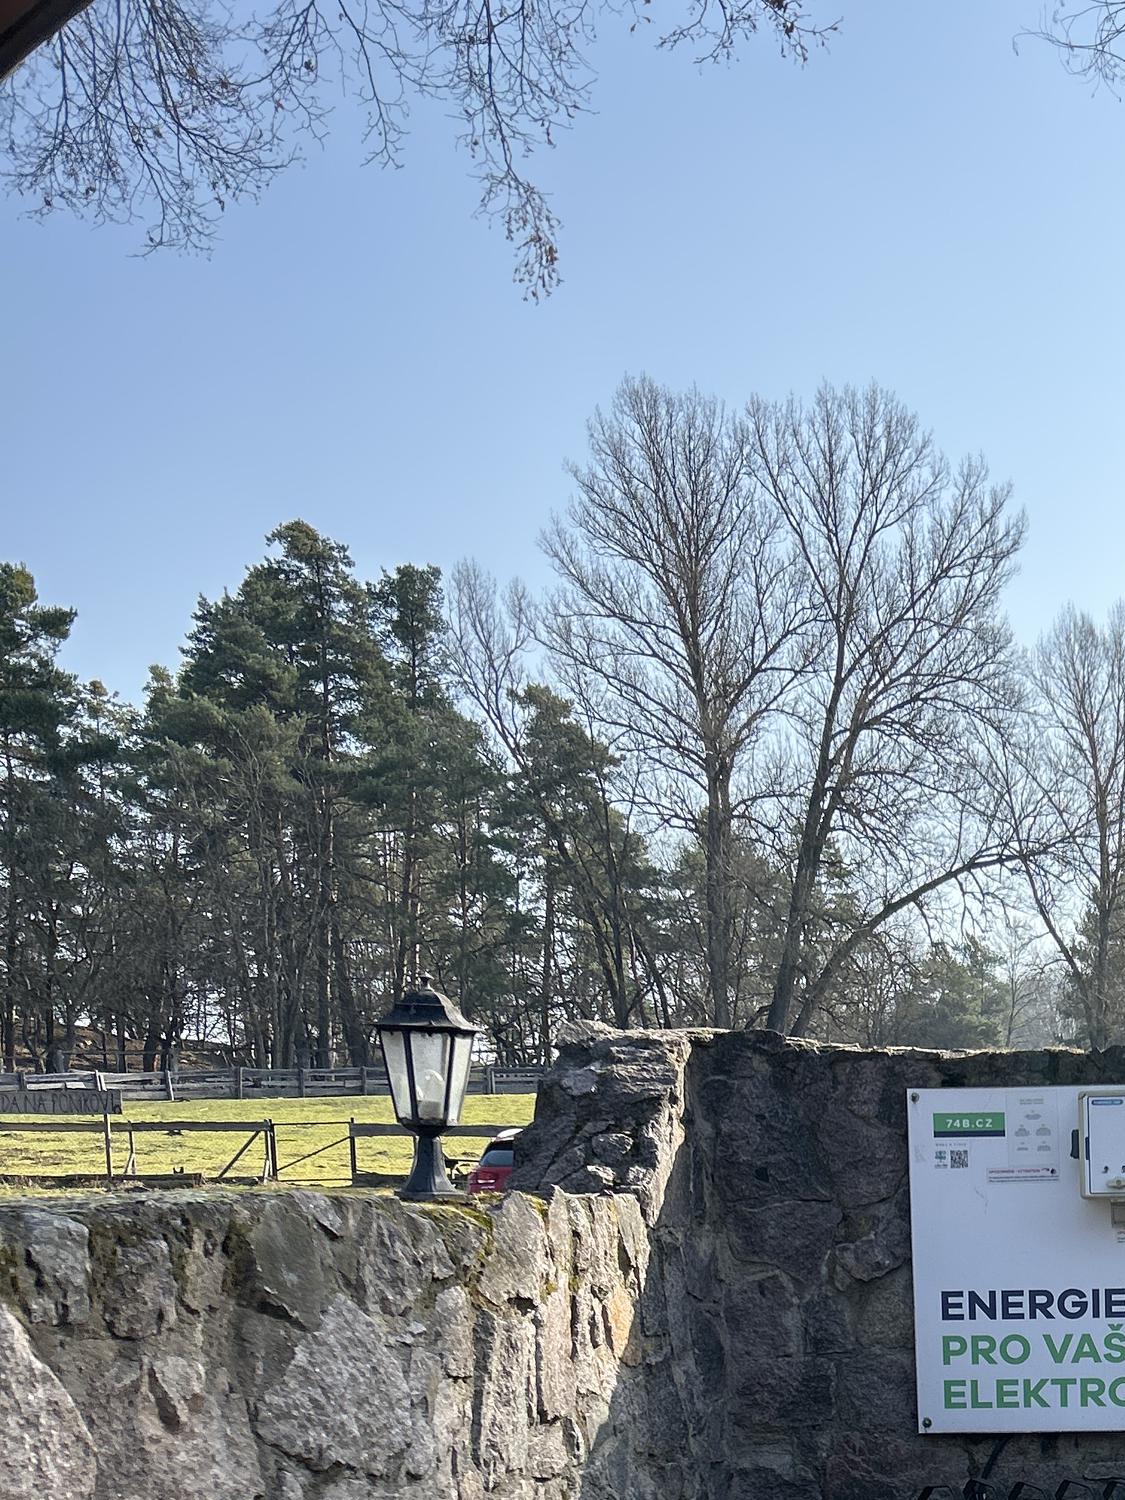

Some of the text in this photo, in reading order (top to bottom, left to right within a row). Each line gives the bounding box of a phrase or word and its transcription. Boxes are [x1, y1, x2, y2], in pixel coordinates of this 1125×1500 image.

[24, 1094, 47, 1113] NA
[945, 1118, 993, 1129] 74B.CZ
[942, 1334, 1031, 1365] PRO
